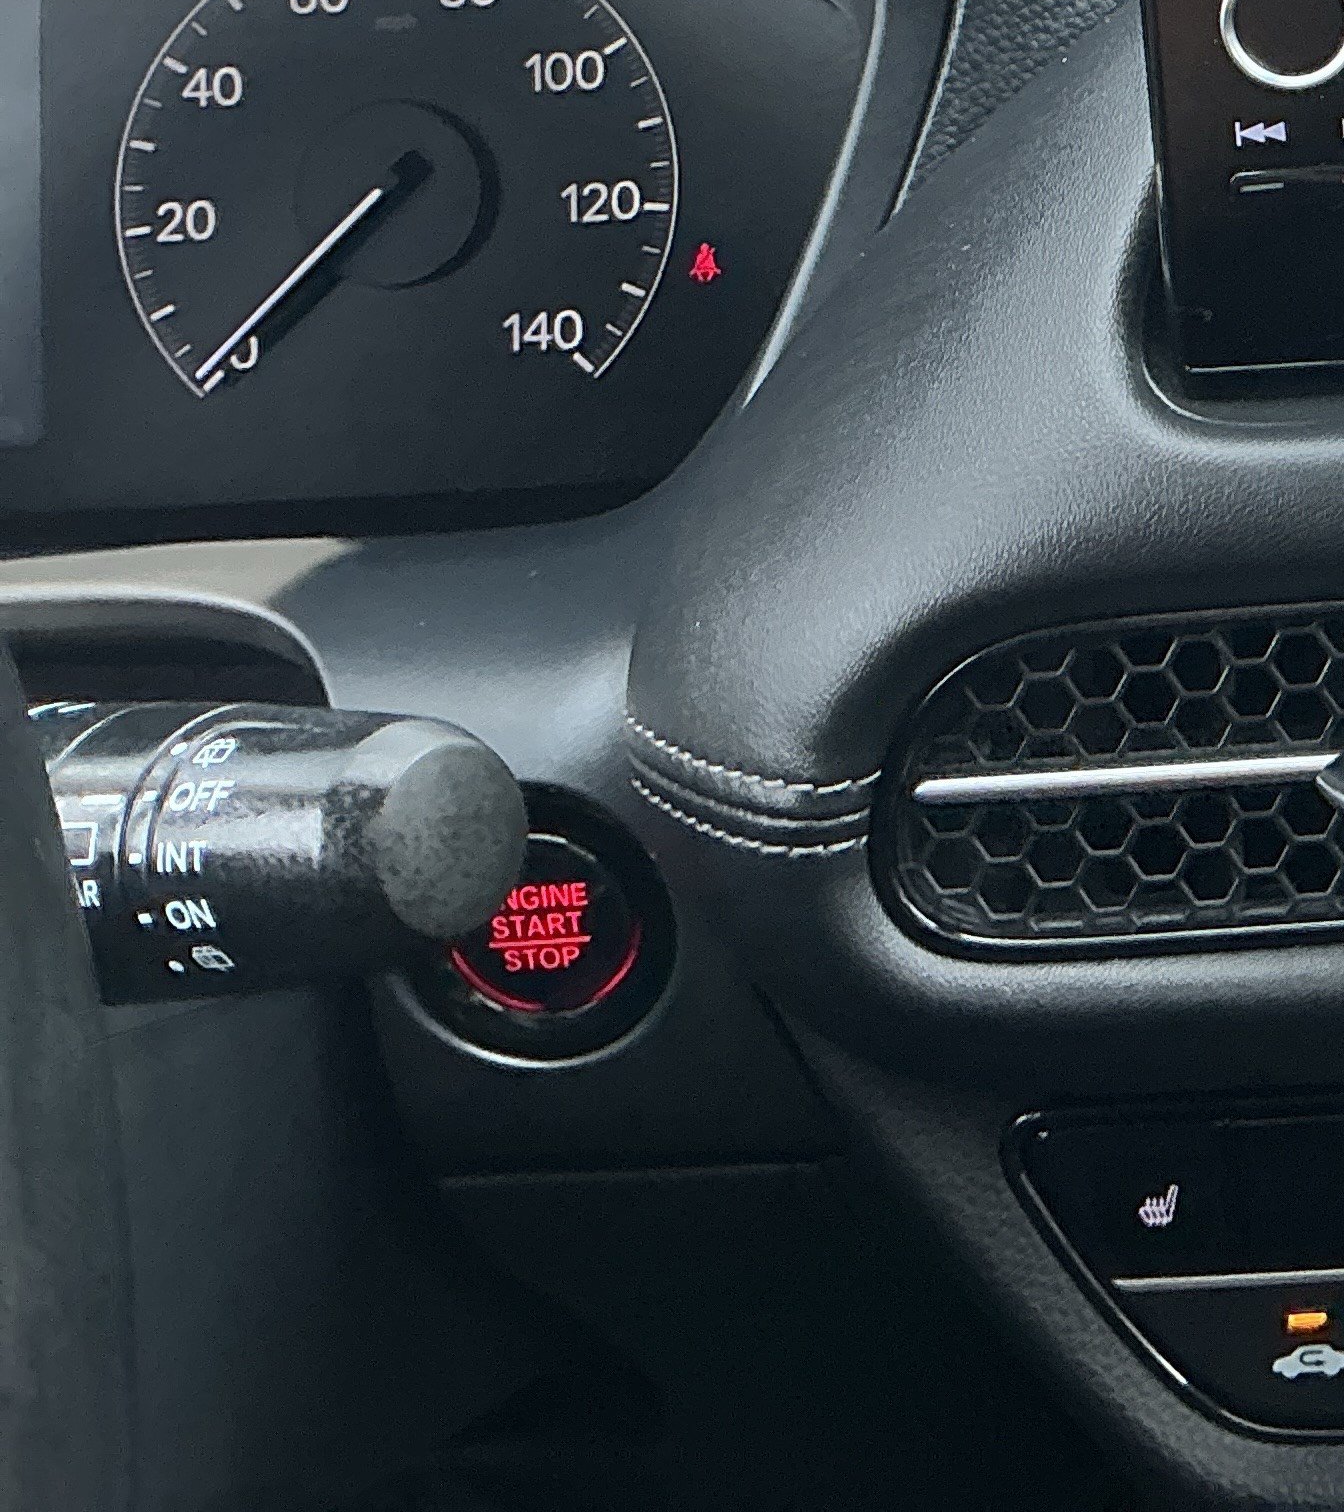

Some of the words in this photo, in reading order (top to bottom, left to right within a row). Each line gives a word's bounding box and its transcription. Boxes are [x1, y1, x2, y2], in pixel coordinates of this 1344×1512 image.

[181, 66, 243, 107] 40
[525, 50, 605, 92] 100
[561, 180, 641, 223] 120
[156, 200, 216, 243] 20
[503, 309, 583, 352] 140
[169, 780, 235, 811] OFF
[157, 841, 207, 873] INT
[500, 882, 588, 910] NGINE
[165, 898, 216, 930] ON
[491, 911, 582, 939] START
[504, 946, 580, 972] STOP
